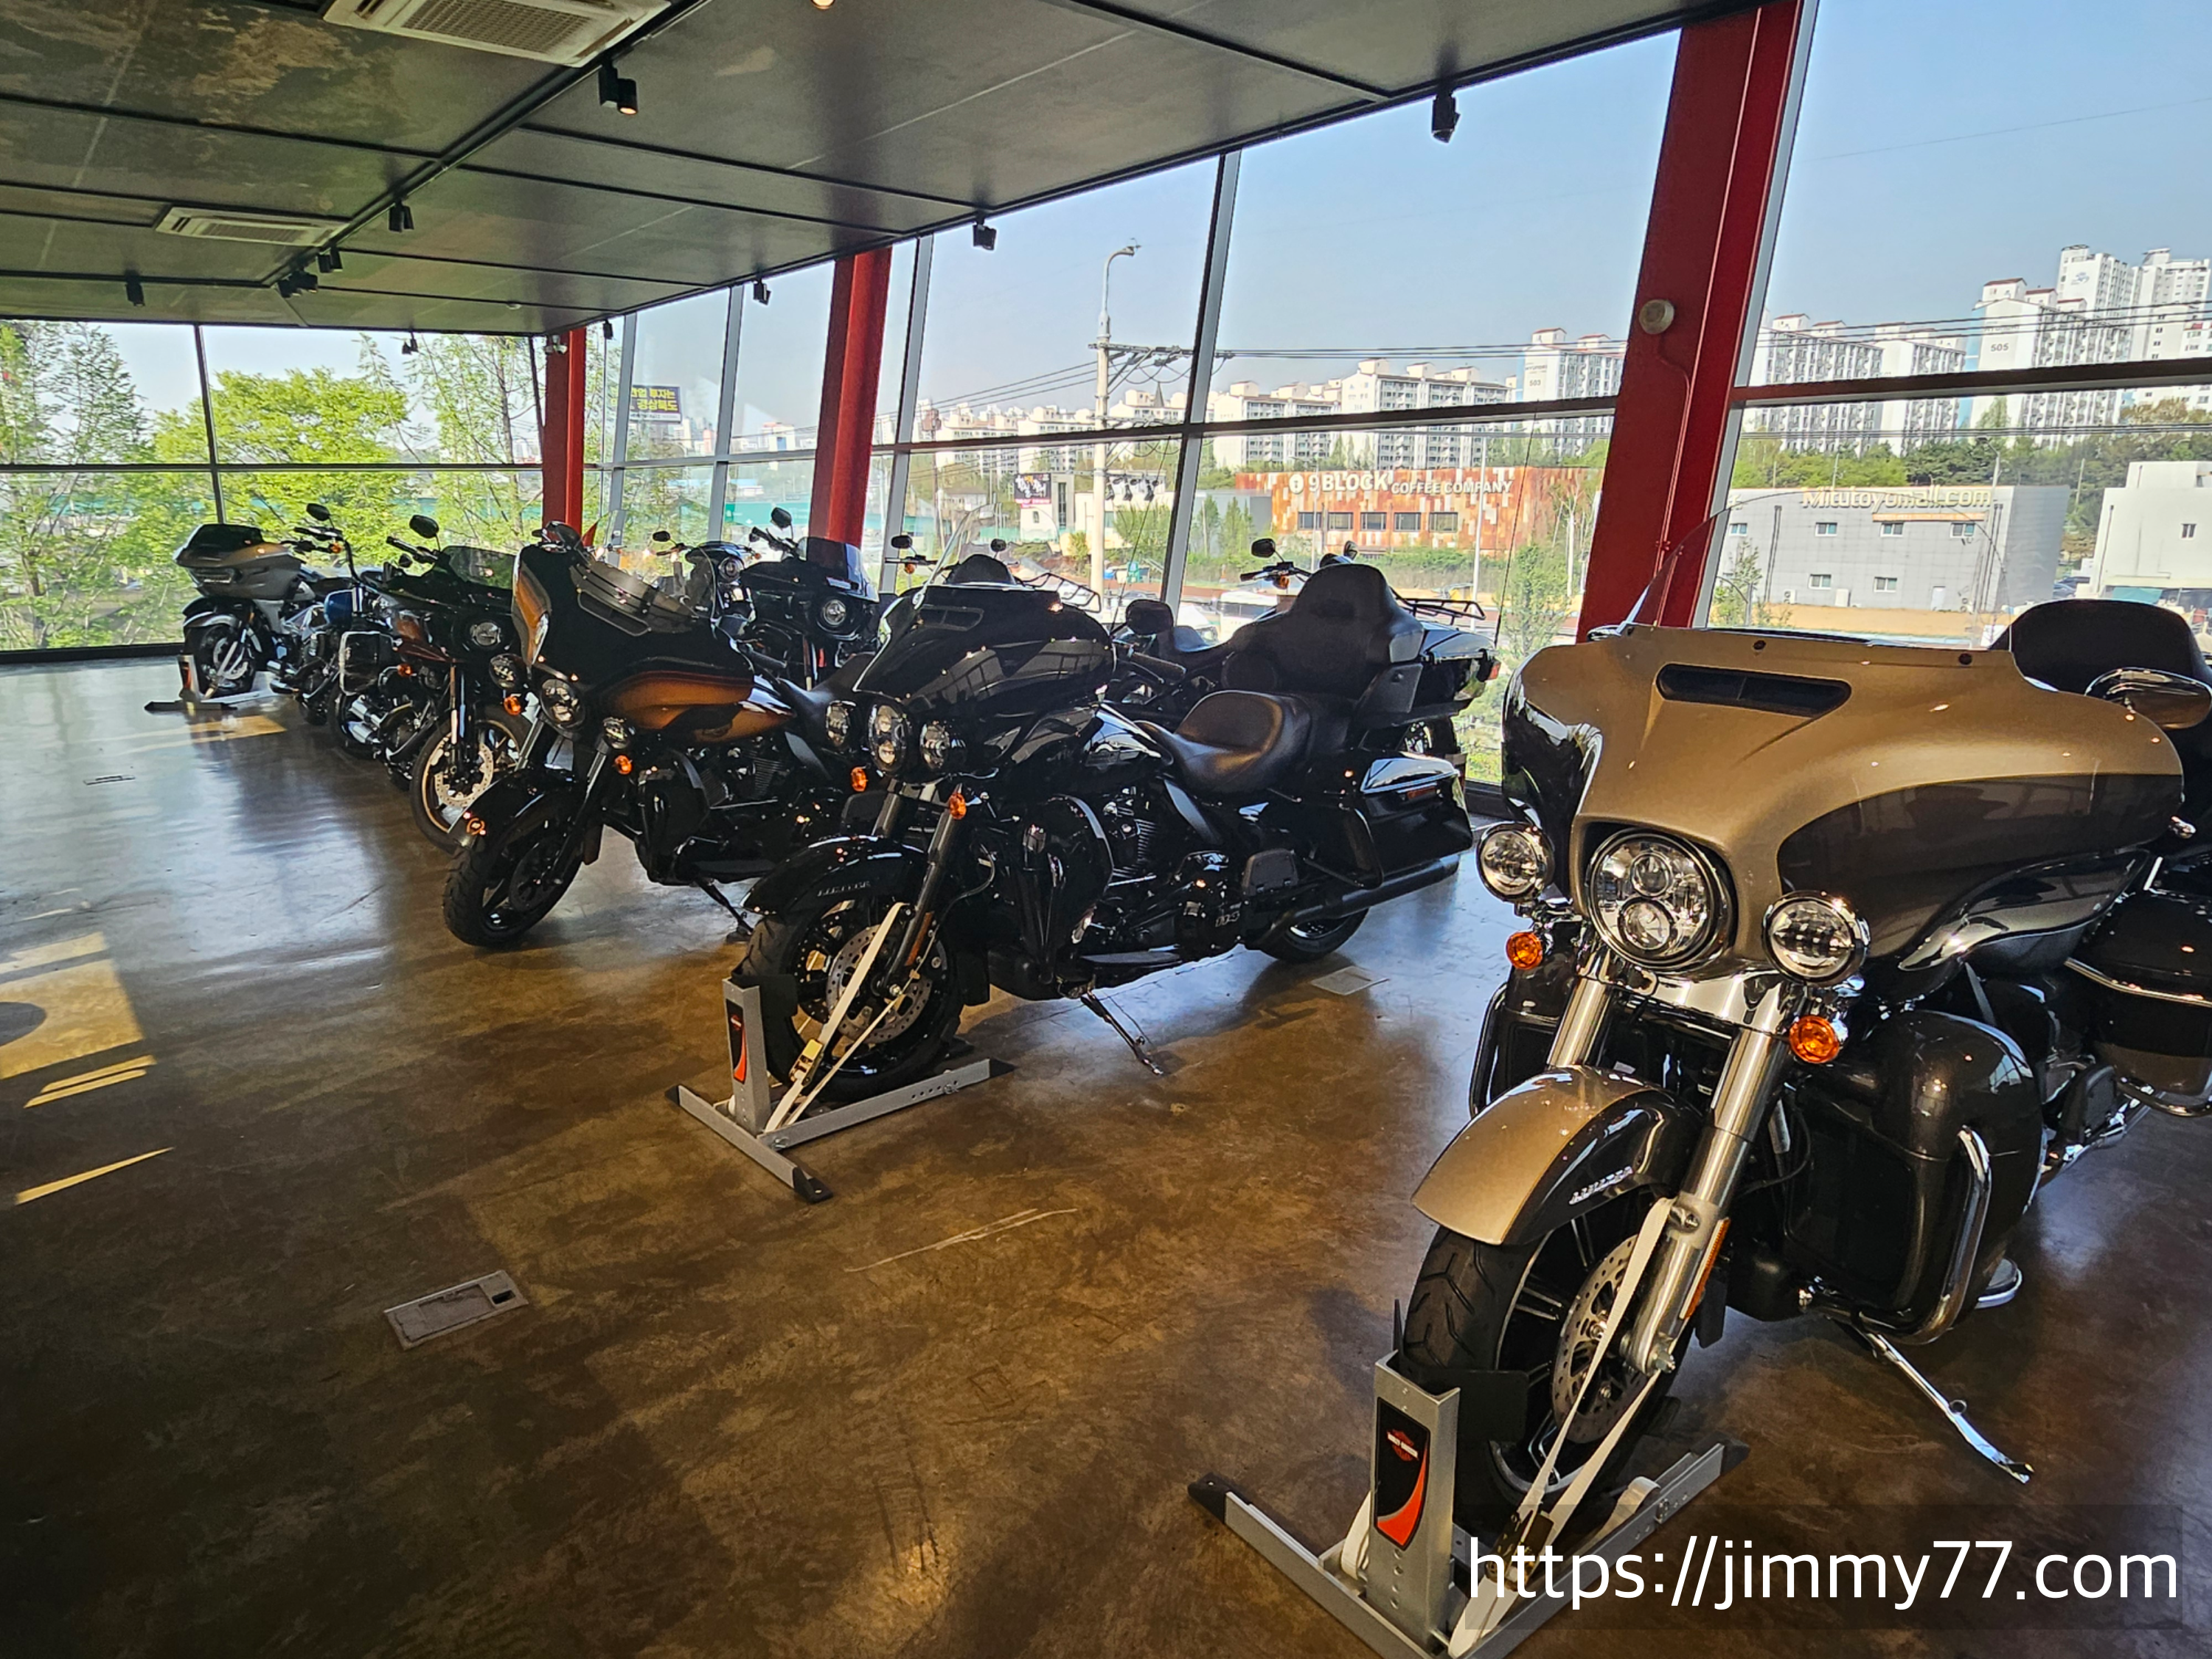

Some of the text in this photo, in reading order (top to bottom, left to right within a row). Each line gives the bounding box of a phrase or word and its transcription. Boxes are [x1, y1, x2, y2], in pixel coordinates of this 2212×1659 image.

[1990, 342, 2008, 352] 505
[637, 399, 678, 411] 경상북도
[1391, 481, 1441, 495] COFFEE
[1802, 485, 1992, 514] Mitutoyomall.com
